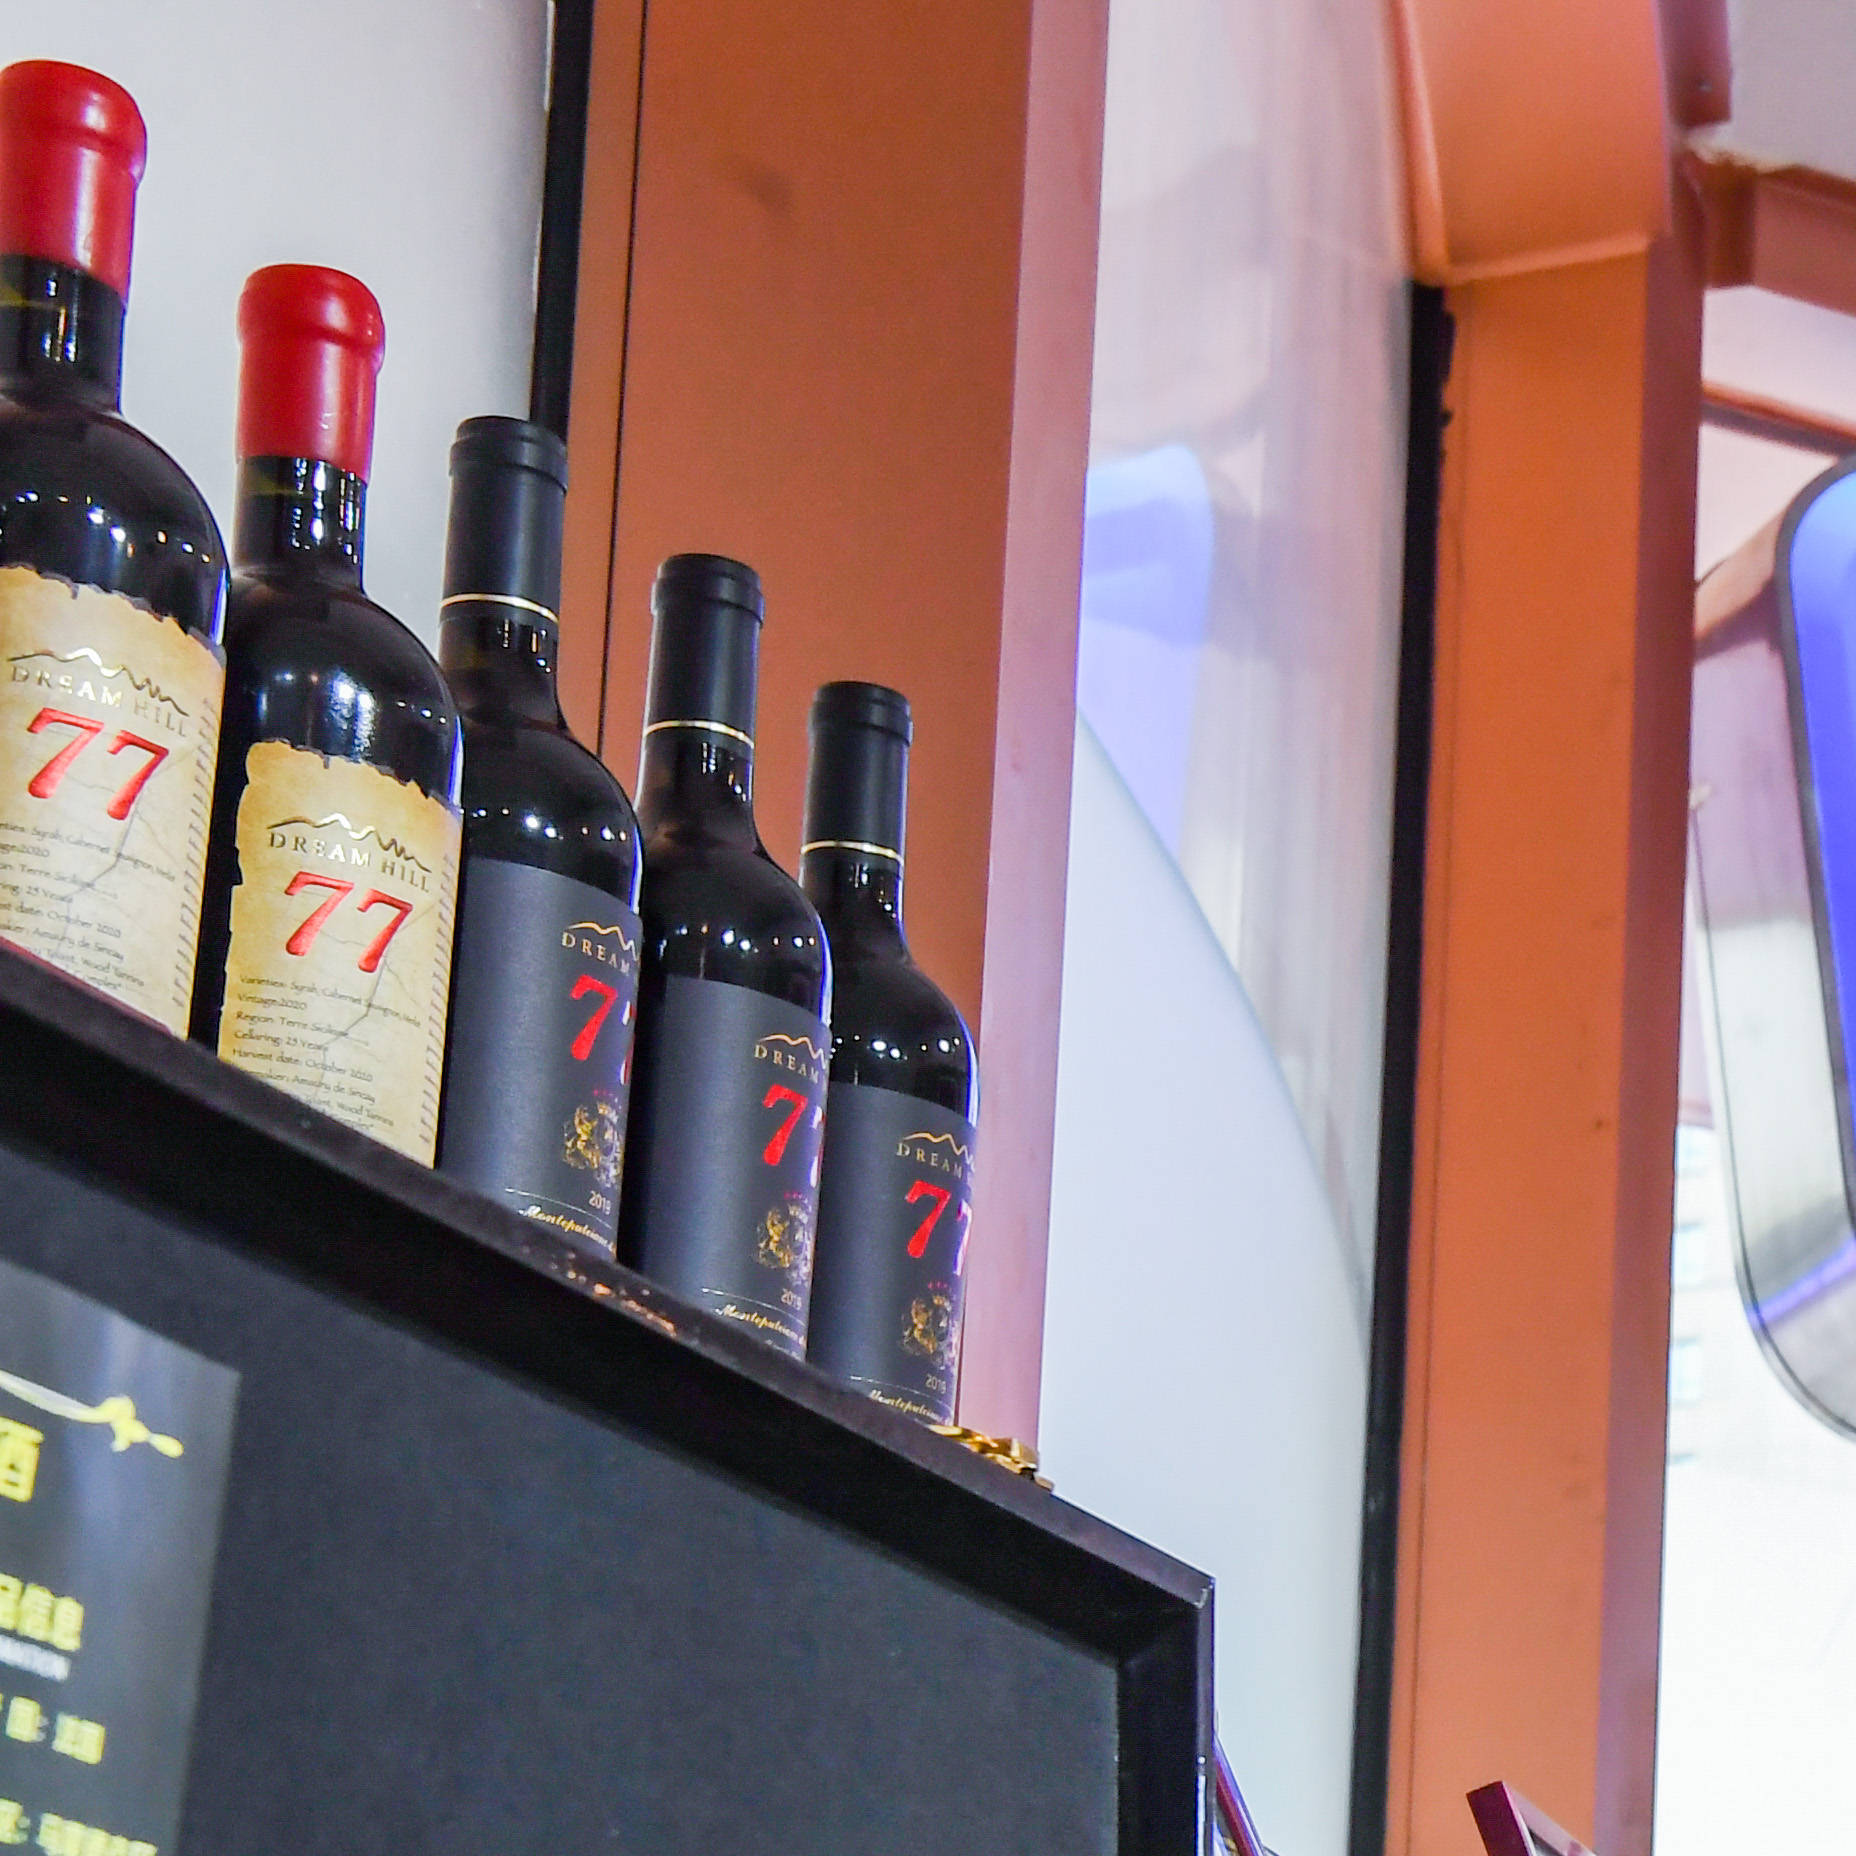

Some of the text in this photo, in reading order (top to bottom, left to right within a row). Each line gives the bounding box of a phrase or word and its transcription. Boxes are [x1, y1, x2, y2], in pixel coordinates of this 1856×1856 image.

[12, 666, 188, 738] DREAM HILL
[27, 707, 170, 821] 77
[269, 831, 431, 895] DREAM HILL
[284, 870, 414, 974] 77
[560, 929, 632, 977] DREAM
[753, 1042, 821, 1086] DREAM
[896, 1141, 964, 1181] DREAM
